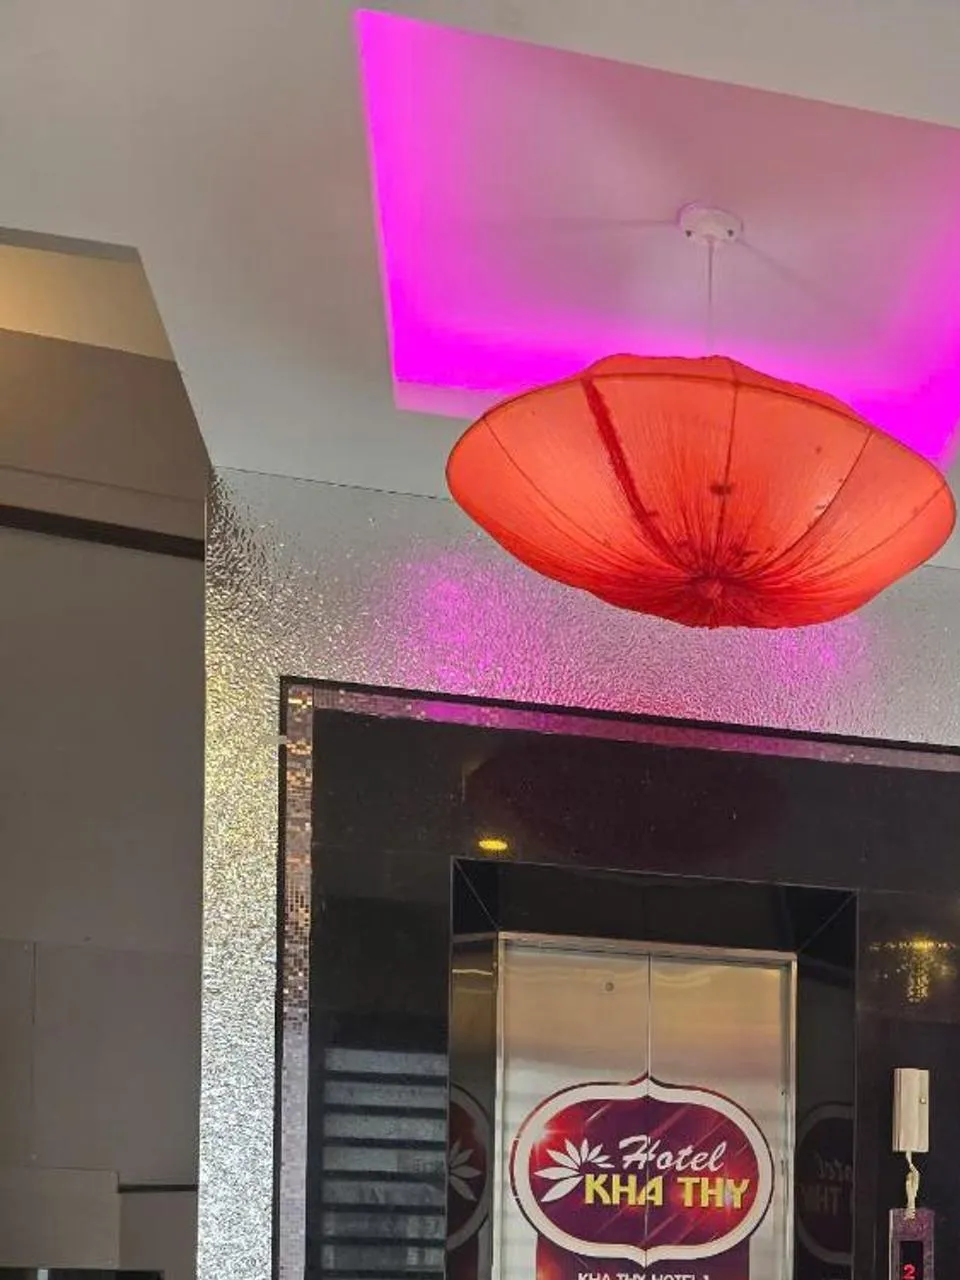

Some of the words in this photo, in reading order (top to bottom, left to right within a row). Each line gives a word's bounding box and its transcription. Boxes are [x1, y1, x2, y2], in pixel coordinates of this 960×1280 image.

[618, 1135, 727, 1173] Hotel
[584, 1173, 664, 1206] KHA
[677, 1177, 750, 1209] THY
[903, 1264, 915, 1280] 2
